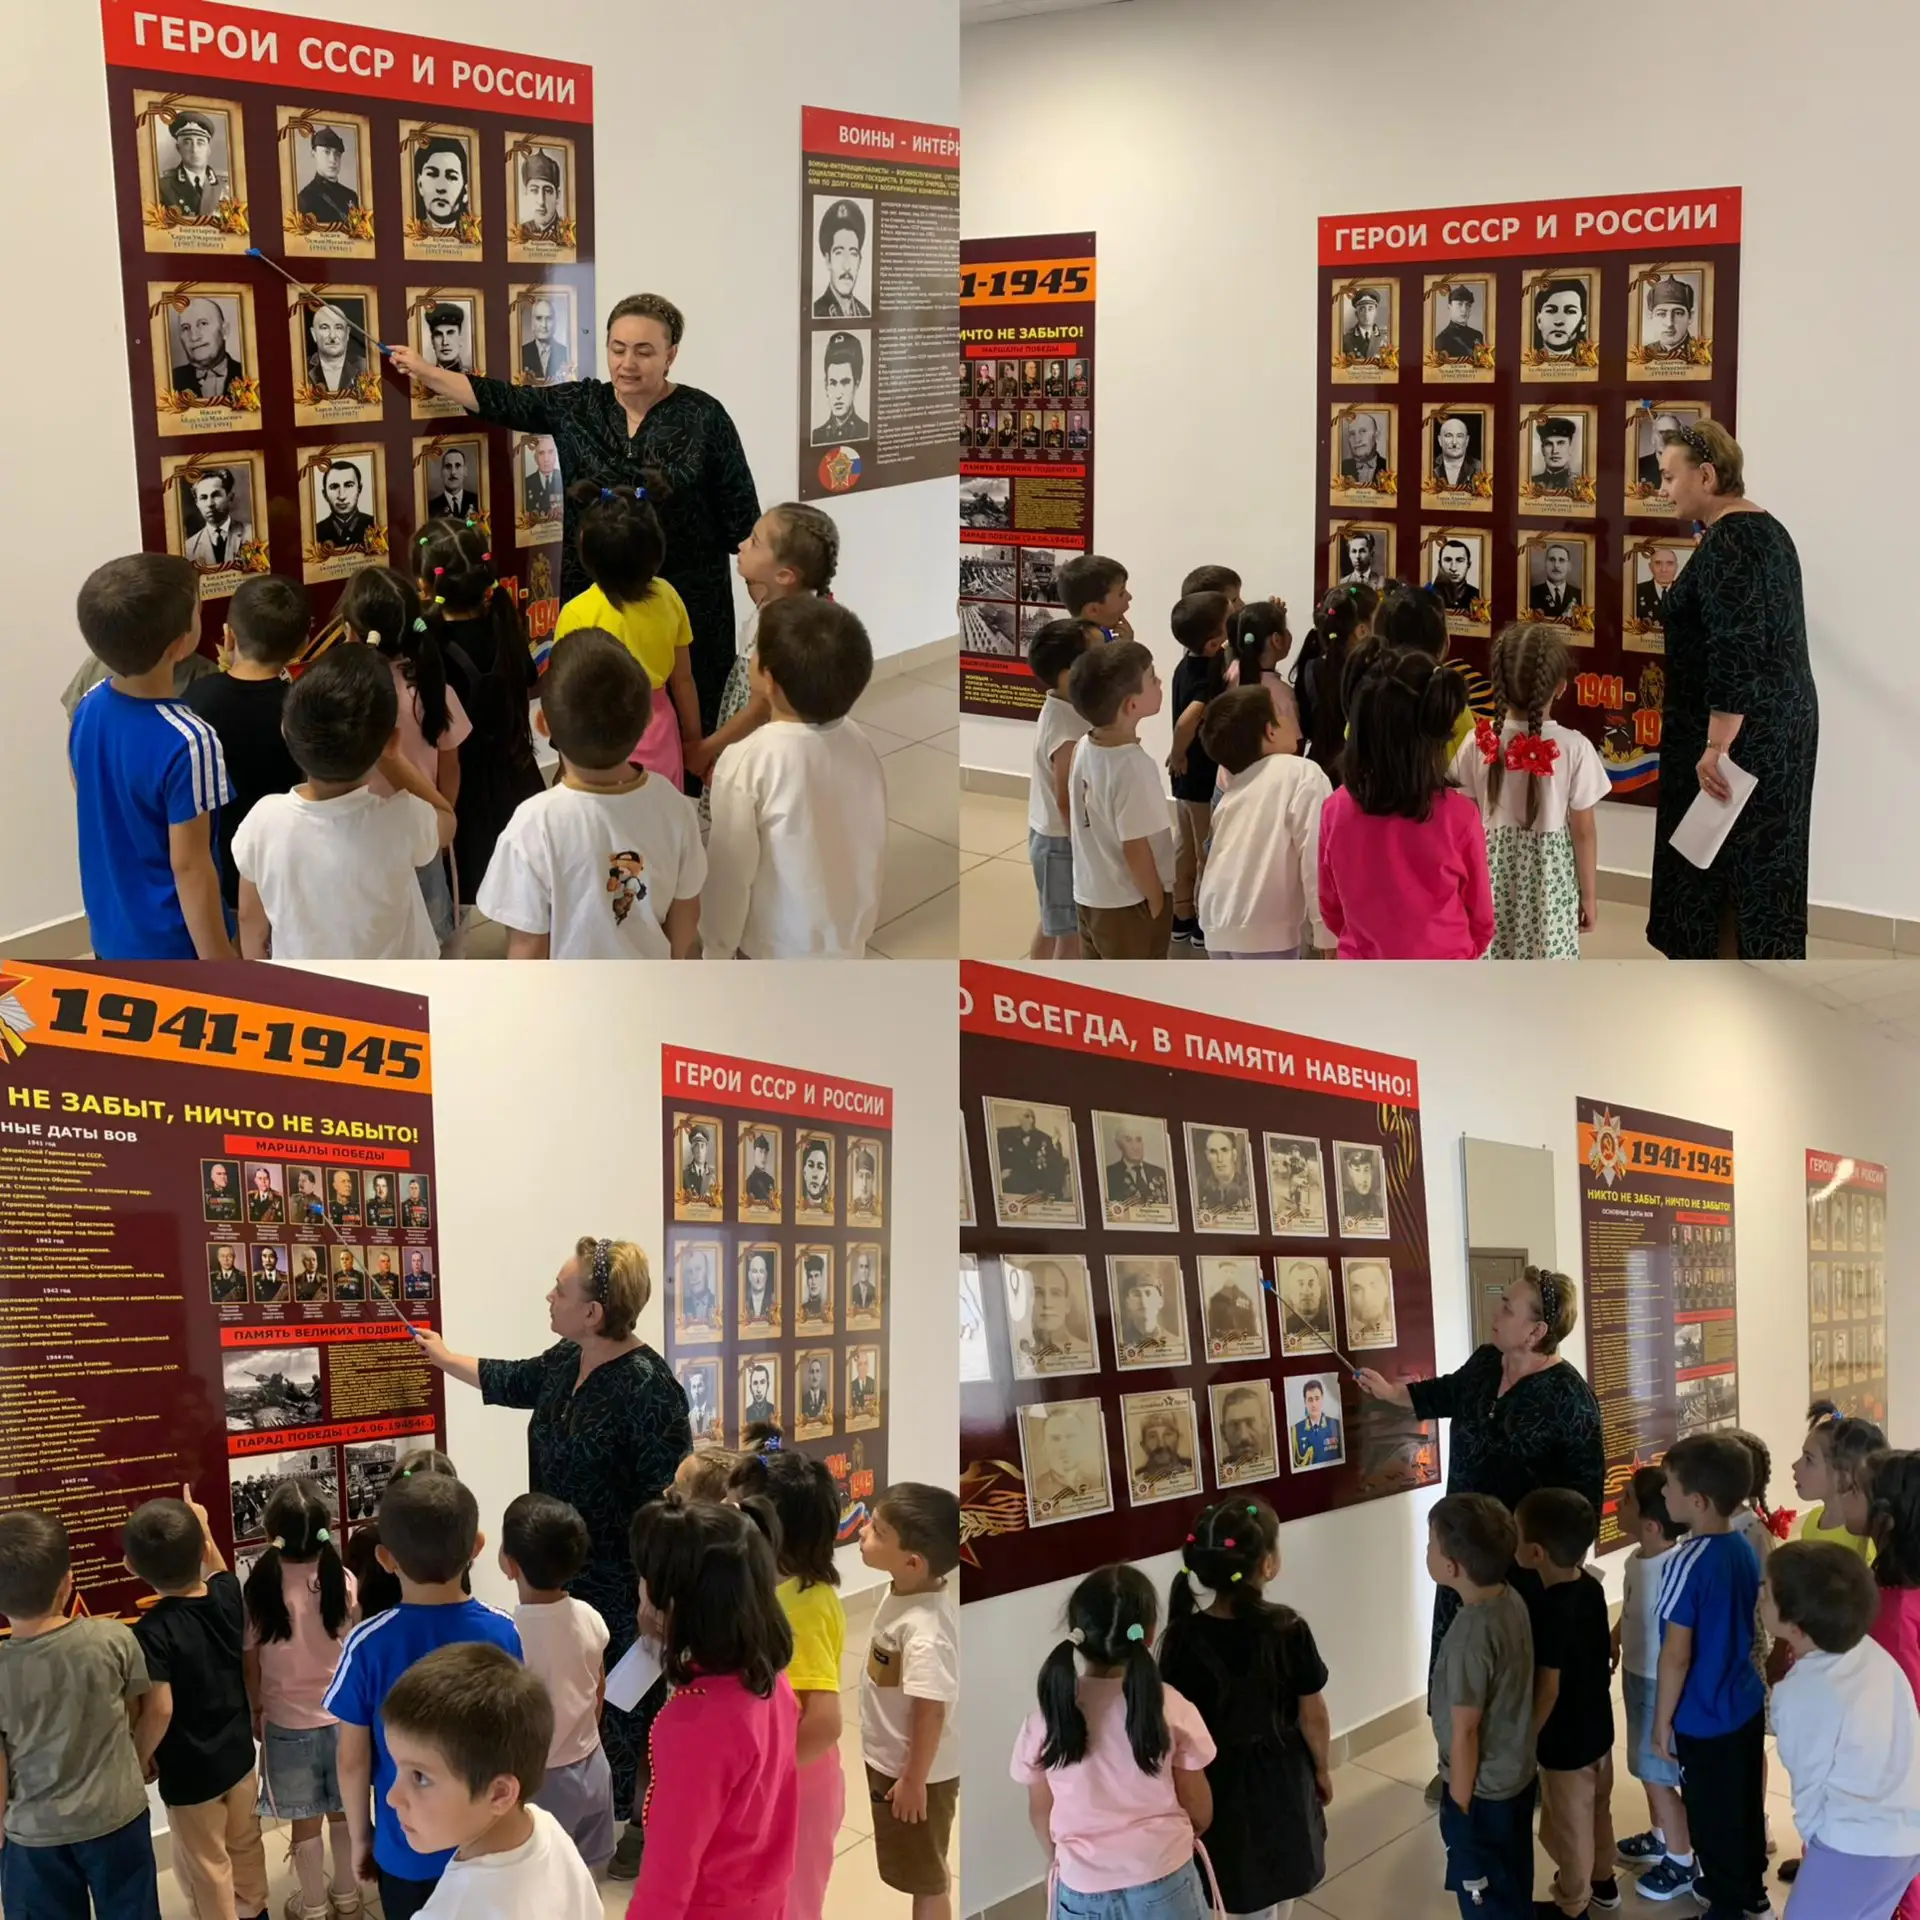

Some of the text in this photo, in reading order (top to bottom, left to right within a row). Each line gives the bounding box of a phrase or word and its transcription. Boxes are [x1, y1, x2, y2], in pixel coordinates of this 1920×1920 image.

[133, 11, 575, 104] ГЕРОИ СССР И РОССИИ
[839, 126, 894, 149] ВОИНЫ
[1335, 203, 1718, 251] ГЕРОИ СССР И РОССИИ
[997, 328, 1016, 339] НЕ
[1019, 326, 1084, 339] ЗАБЫТО!
[526, 596, 560, 638] 194
[1574, 672, 1636, 710] 1941-
[1632, 707, 1661, 747] 19
[50, 988, 423, 1080] 1941-1945
[994, 994, 1137, 1053] ВСЕГДА,
[1153, 1026, 1171, 1053] В
[1185, 1034, 1295, 1076] ПАМЯТИ
[1306, 1057, 1412, 1098] НАВЕЧНО!
[675, 1060, 884, 1116] ГЕРОИ СССР И РОССИИ
[1, 1121, 138, 1143] НЫЕ ДАТЫ ВОВ
[8, 1087, 419, 1144] НЕ ЗАБЫТ, НИЧТО НЕ ЗАБЫТО!
[256, 1141, 385, 1161] МАРШАЛЫ ПОБЕДЫ
[1631, 1140, 1732, 1177] 1941-1945
[1809, 1156, 1834, 1175] ГЕРОИ
[1587, 1188, 1731, 1211] НИКТО НЕ ЗАБЫТ, НИЧТО НЕ ЗАБЫТО!
[234, 1329, 291, 1341] ПАМЯТЬ
[294, 1327, 354, 1338] ВЕЛИКИХ
[236, 1435, 284, 1449] ПАРАД
[287, 1428, 342, 1444] ПОБЕДЫ
